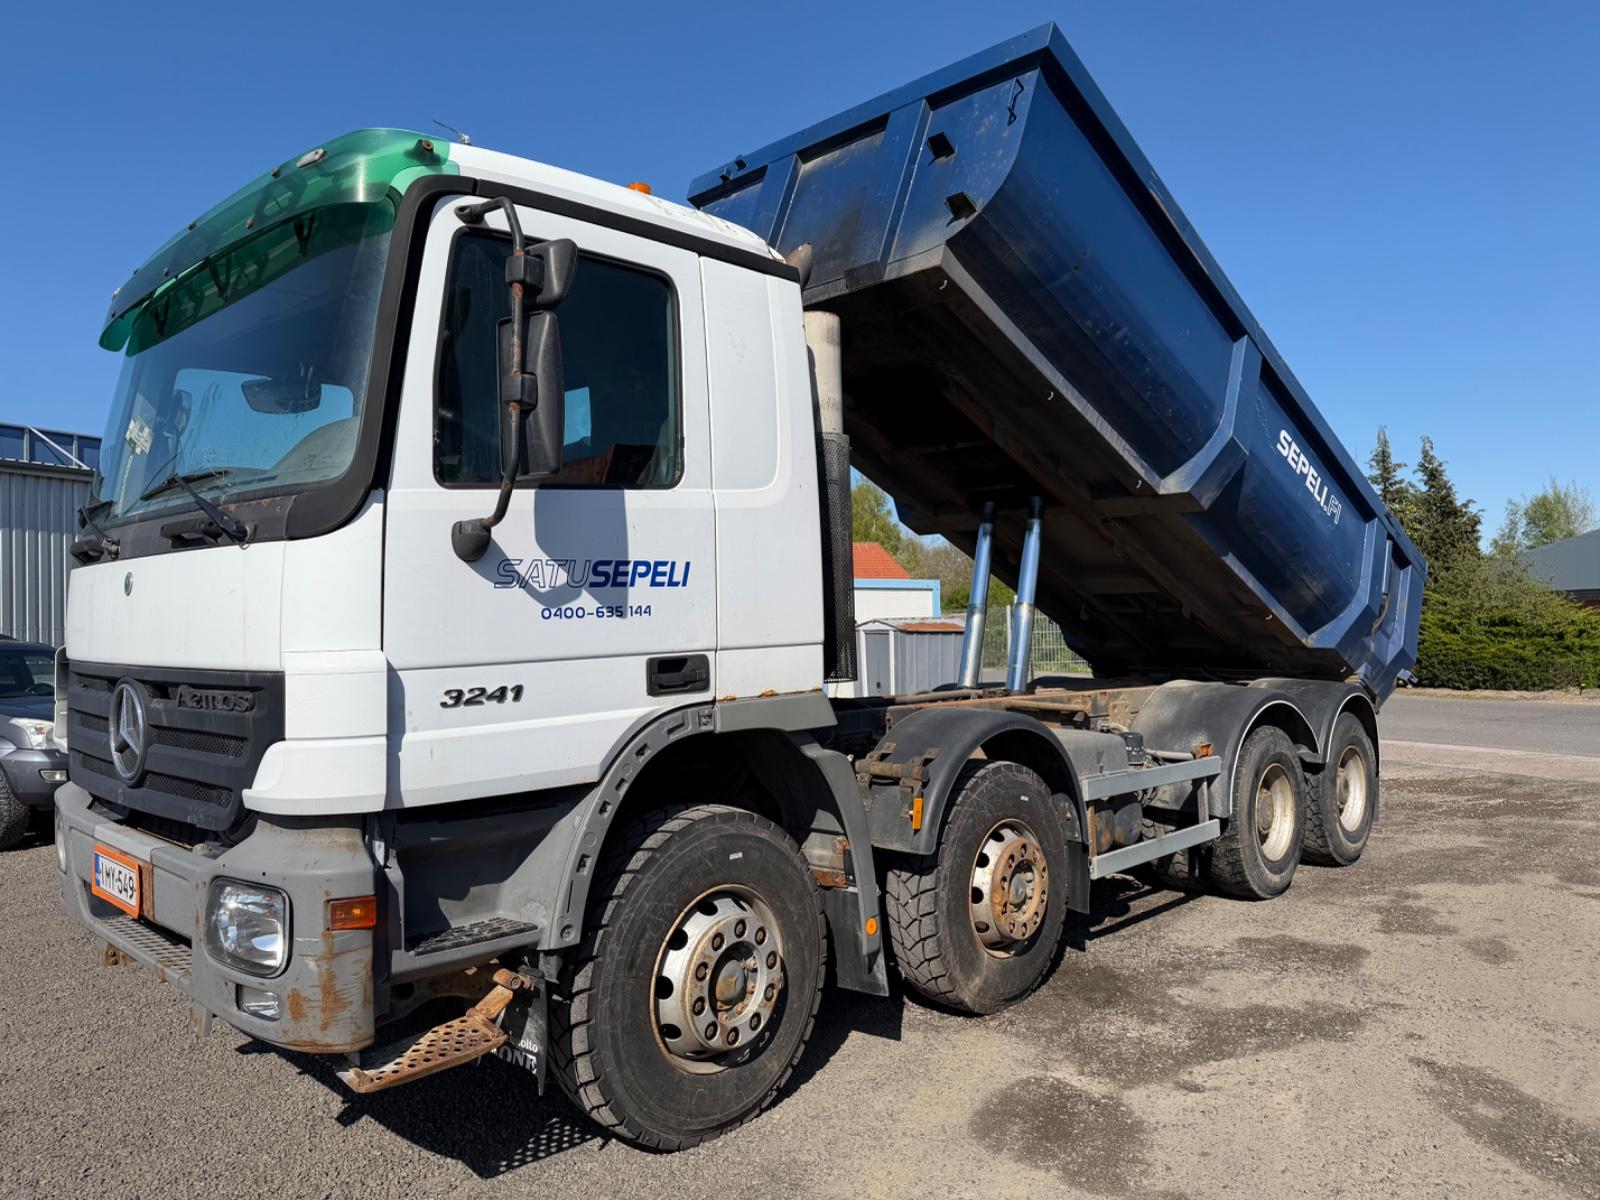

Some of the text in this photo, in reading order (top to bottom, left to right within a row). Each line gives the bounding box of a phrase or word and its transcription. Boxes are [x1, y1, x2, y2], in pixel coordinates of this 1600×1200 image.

[493, 558, 691, 589] SATUSEPELI
[540, 604, 652, 620] 0400-635 144
[439, 684, 524, 709] 3241
